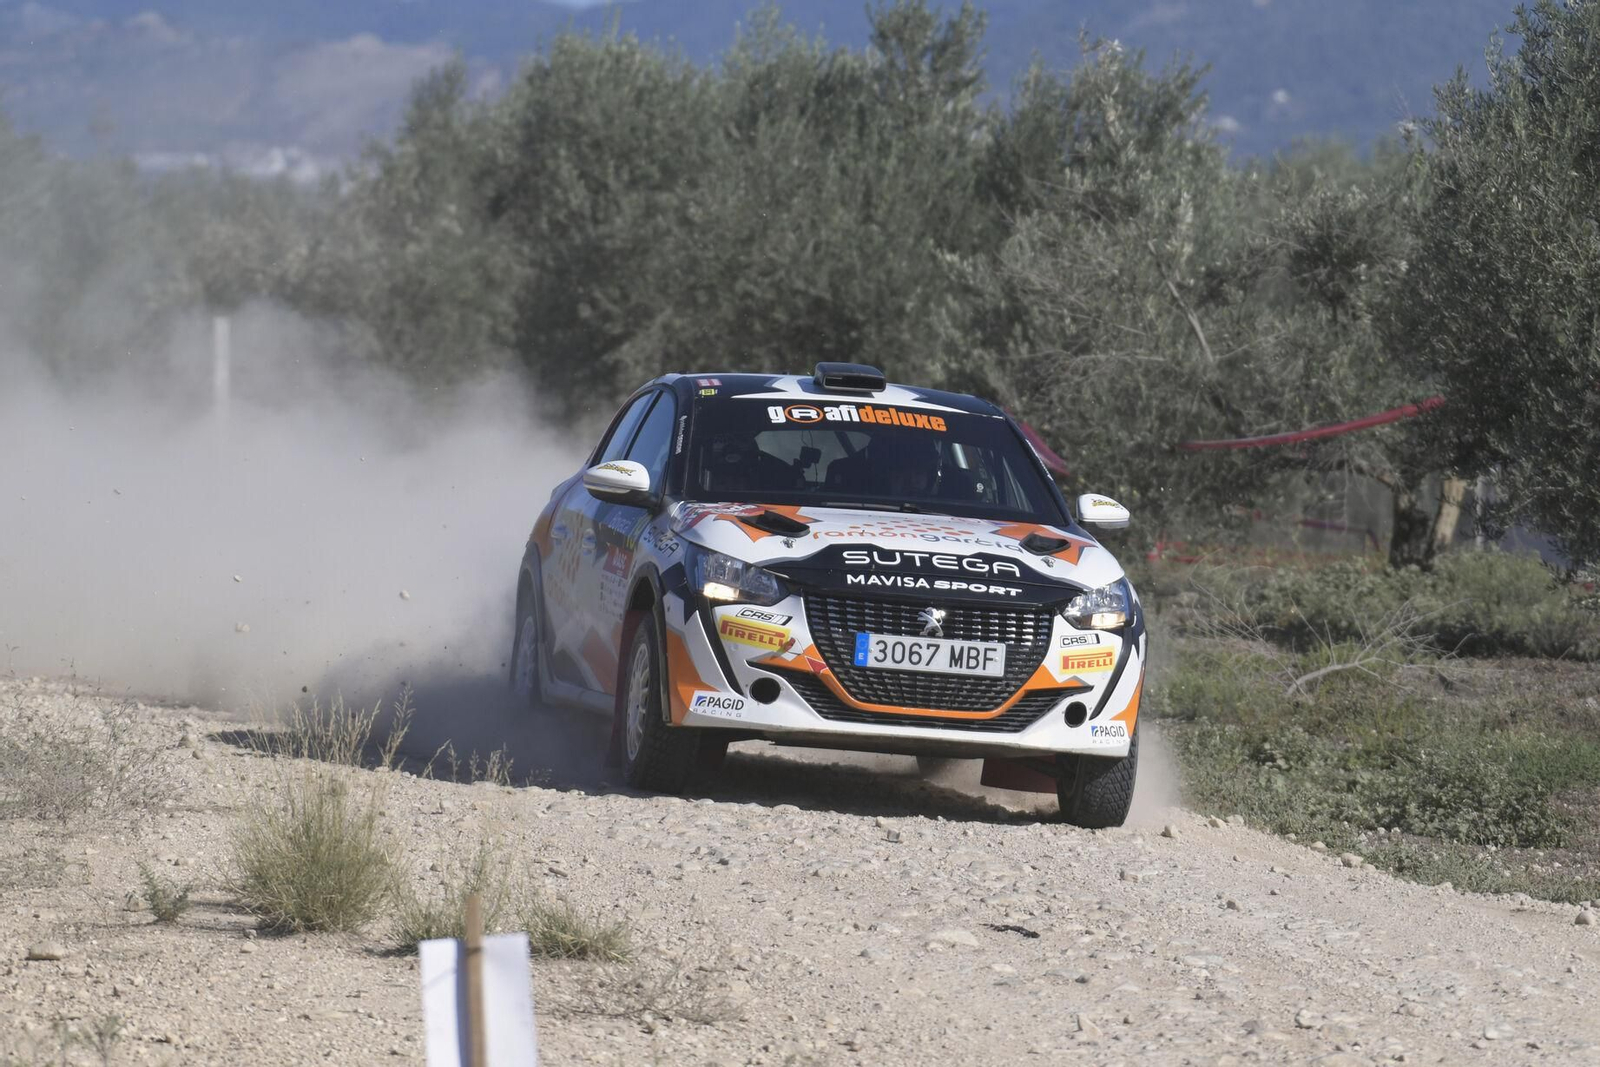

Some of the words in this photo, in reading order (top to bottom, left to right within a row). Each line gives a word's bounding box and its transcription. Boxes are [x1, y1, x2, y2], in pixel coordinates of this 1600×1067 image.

[842, 550, 1021, 578] SUTEGA
[846, 574, 930, 589] MAVISA
[933, 580, 1023, 597] SPORT
[740, 609, 775, 621] CRS
[721, 620, 786, 647] PIRELLI
[1062, 636, 1087, 646] CRS
[873, 639, 940, 667] 3067
[949, 644, 998, 671] MBF
[1062, 651, 1113, 670] PIRELLI
[707, 696, 744, 711] PAGID
[693, 707, 742, 718] RACING
[1099, 725, 1125, 738] PAGID
